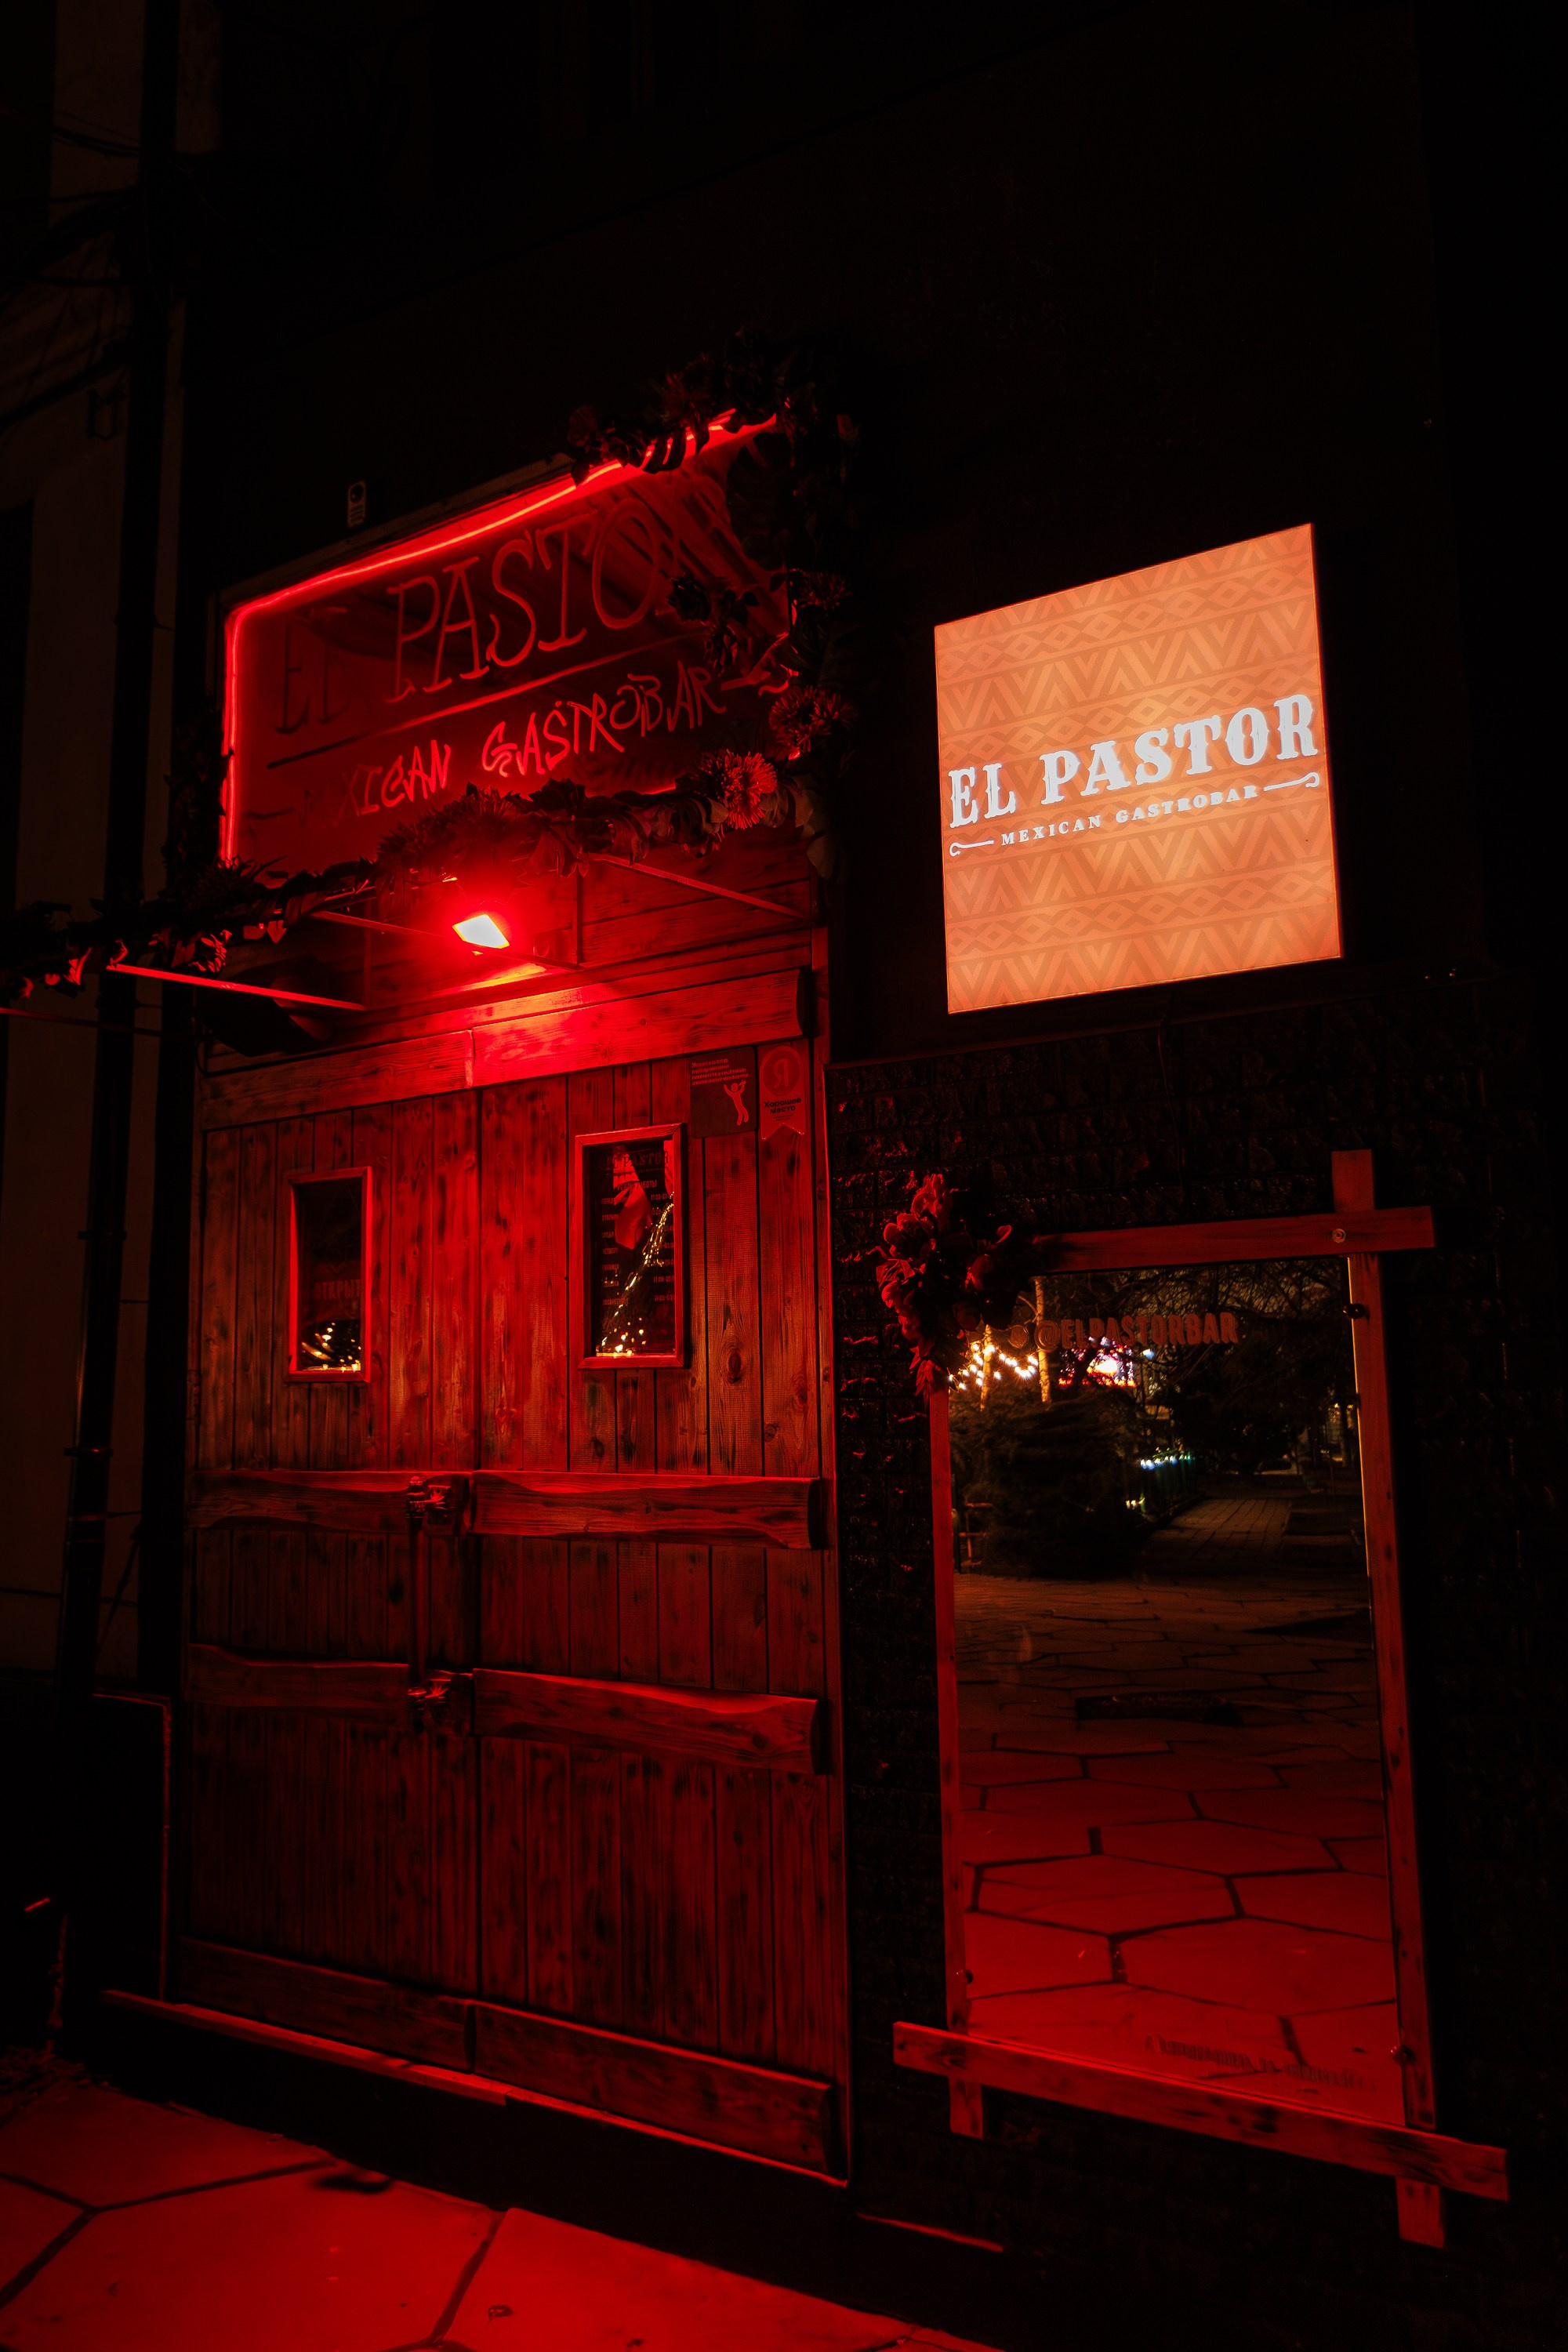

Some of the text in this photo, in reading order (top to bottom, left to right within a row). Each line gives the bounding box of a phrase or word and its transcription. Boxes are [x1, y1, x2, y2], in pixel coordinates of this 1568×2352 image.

[299, 660, 728, 828] MXICAN GASTROBAR
[948, 695, 1319, 828] EL PASTOR
[1000, 785, 1258, 847] MEXICAN GASTROBAR
[1034, 1312, 1239, 1351] @ELPASTORBAR
